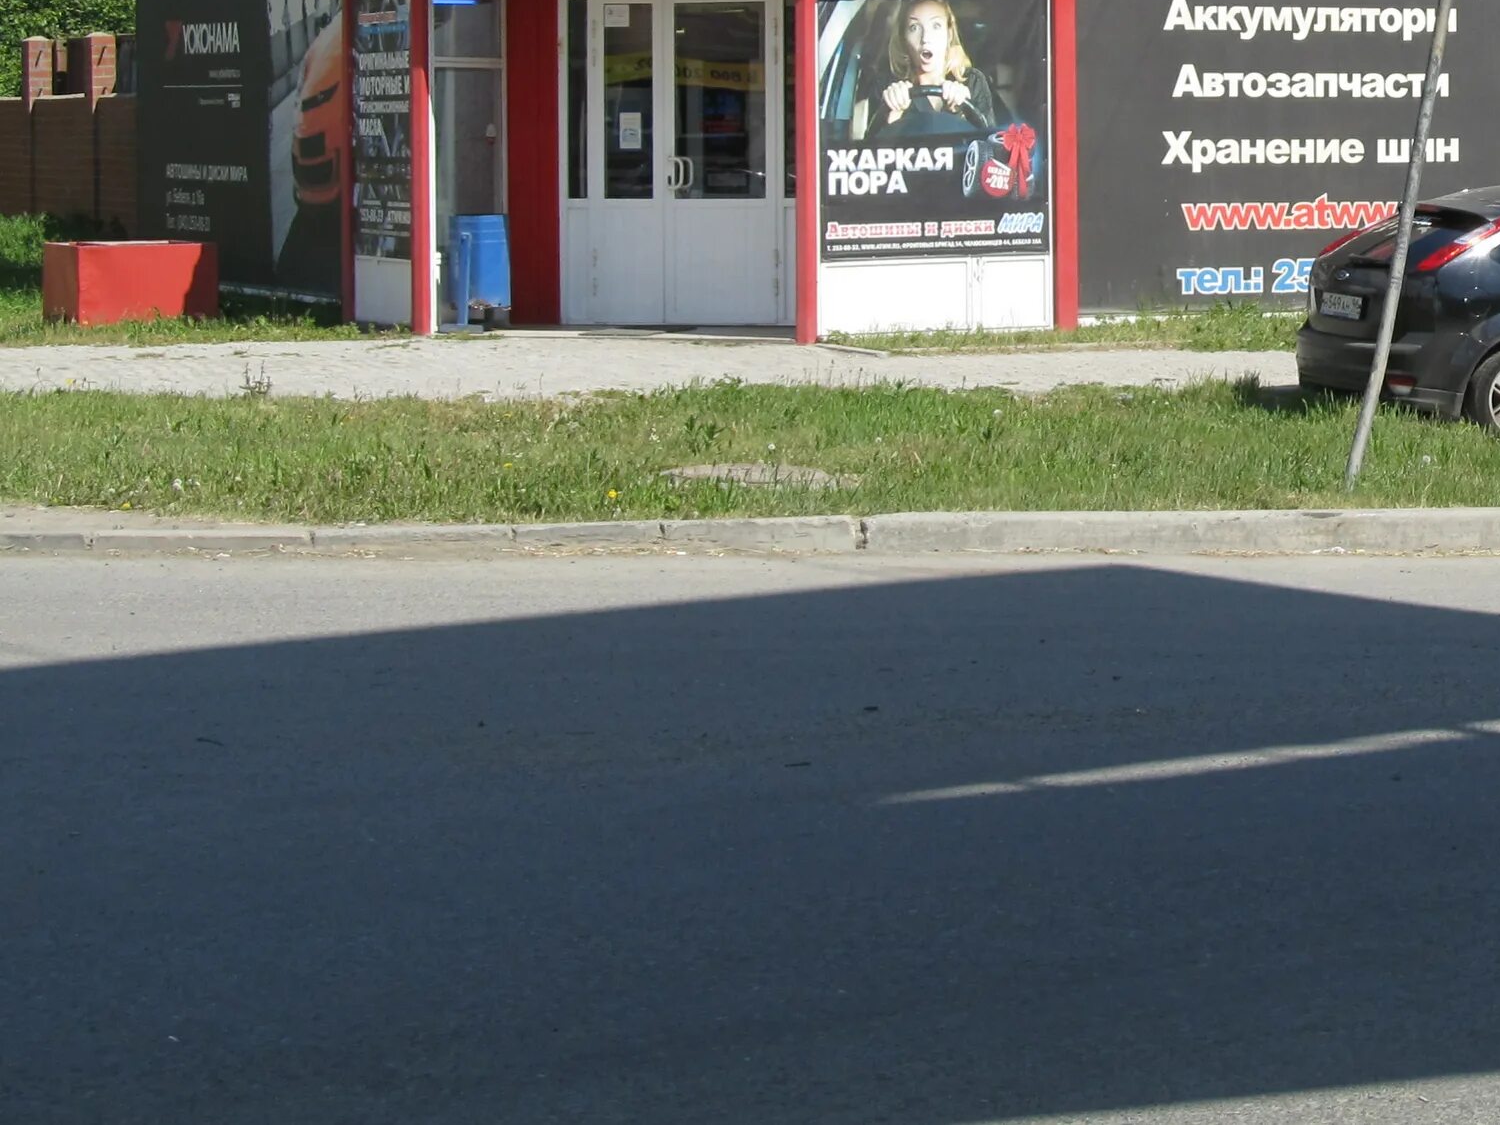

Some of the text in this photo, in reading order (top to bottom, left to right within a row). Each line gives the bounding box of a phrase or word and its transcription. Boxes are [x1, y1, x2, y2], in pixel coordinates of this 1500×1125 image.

[182, 22, 240, 54] YOKOHAMA
[1172, 63, 1450, 99] Автозапчасти
[827, 147, 953, 171] ЖАРКАЯ
[1161, 131, 1365, 172] Хранение
[827, 170, 908, 196] ПОРА
[826, 221, 921, 239] Автошины
[998, 212, 1044, 233] МИРА
[1176, 267, 1264, 295] тел.:
